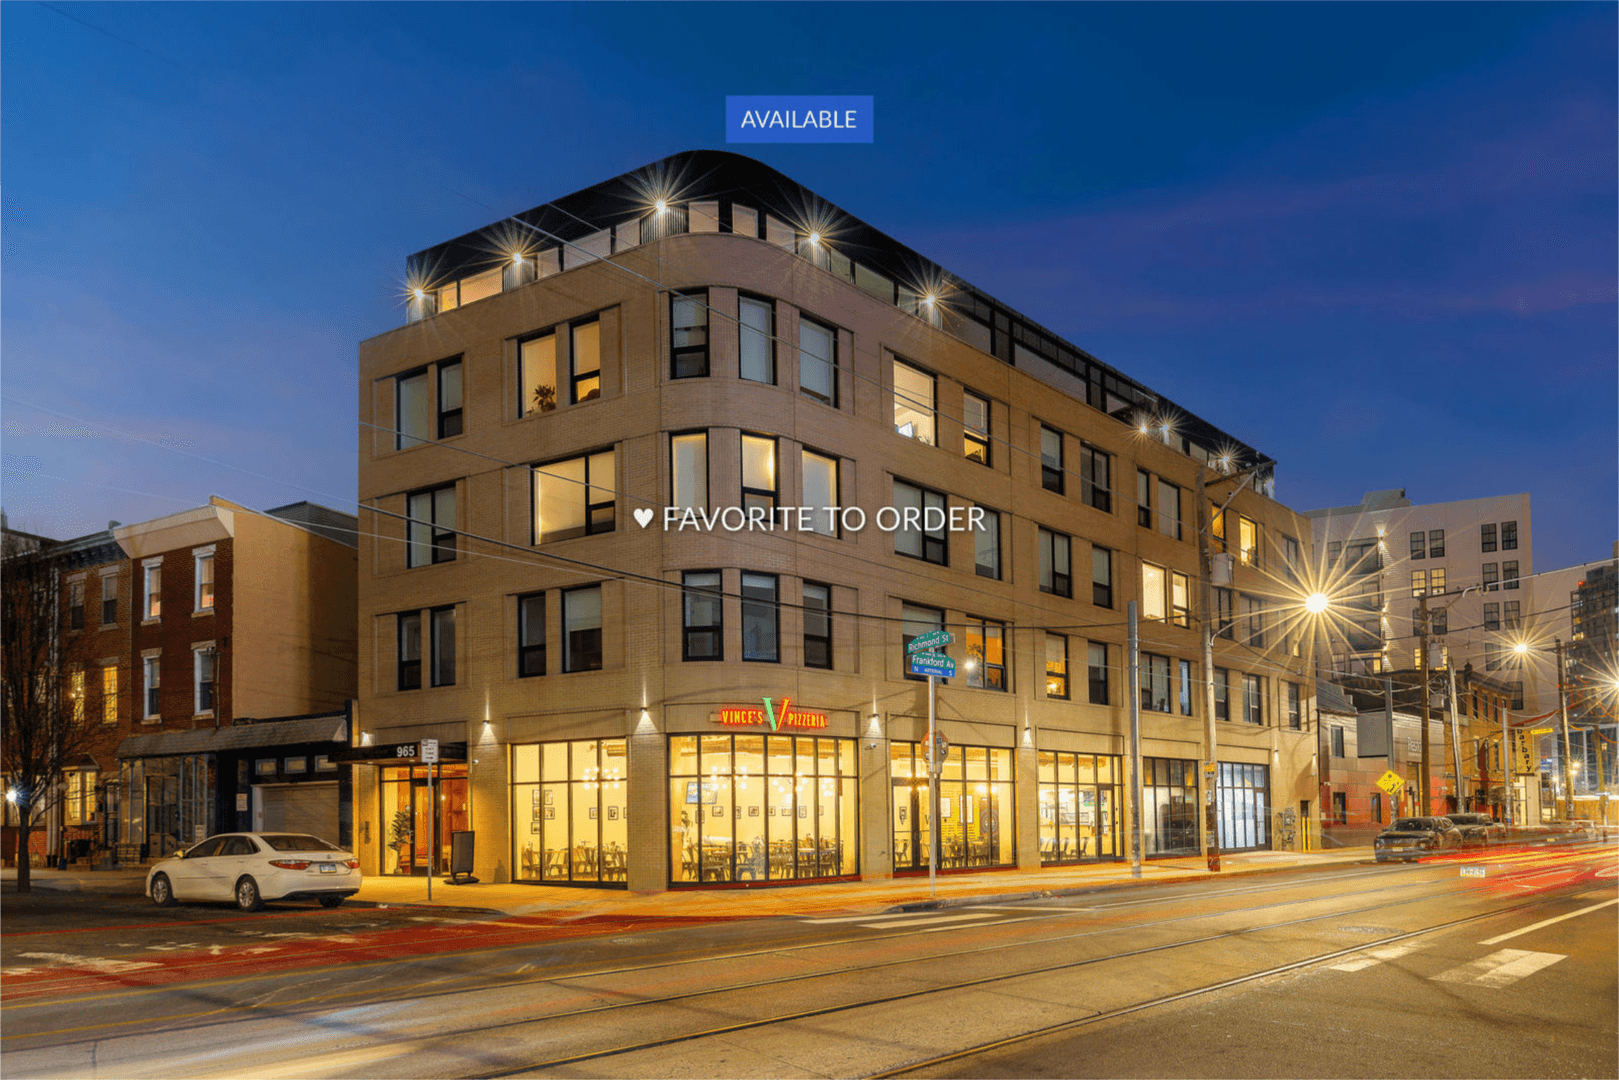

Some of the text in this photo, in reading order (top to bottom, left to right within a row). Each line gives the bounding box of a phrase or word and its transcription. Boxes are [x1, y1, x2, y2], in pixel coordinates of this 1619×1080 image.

[909, 636, 940, 652] Richmond
[941, 634, 949, 643] St
[912, 655, 944, 668] Frankford
[721, 709, 764, 724] VINCE'S
[788, 712, 826, 729] PIZZERIA
[396, 745, 415, 758] 965
